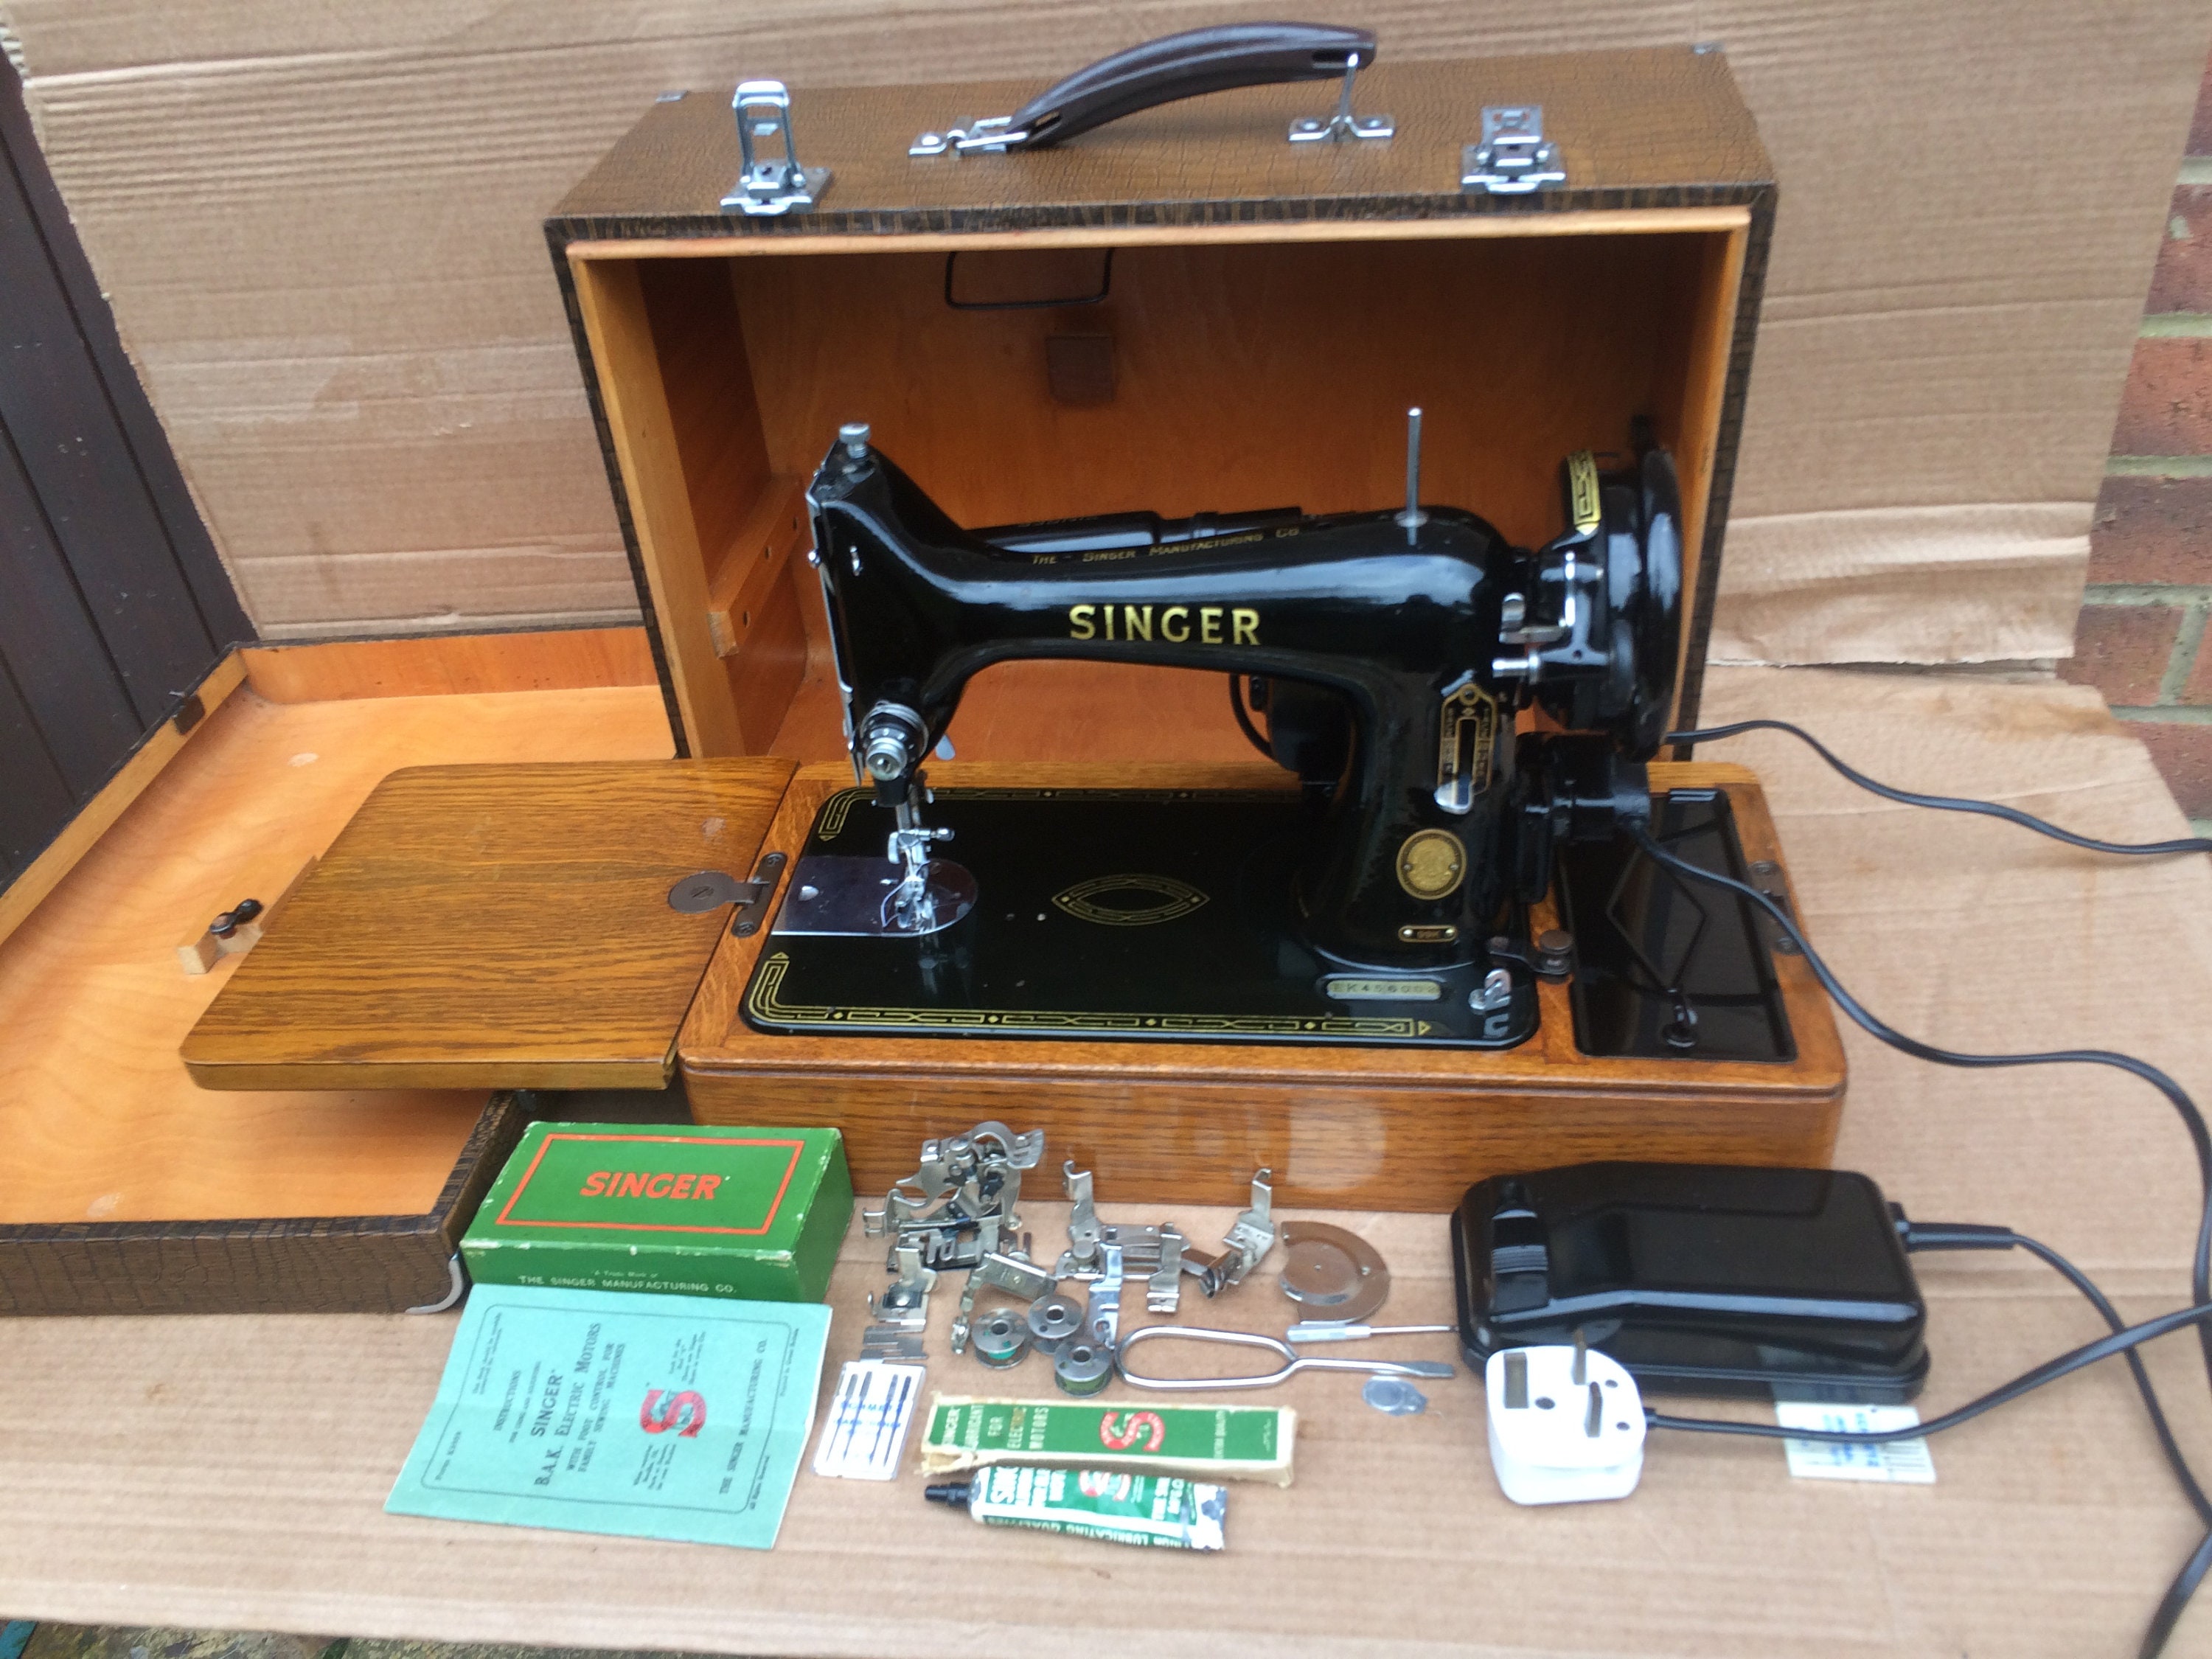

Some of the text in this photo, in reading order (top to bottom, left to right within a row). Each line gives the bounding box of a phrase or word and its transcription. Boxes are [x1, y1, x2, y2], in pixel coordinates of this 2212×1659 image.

[1082, 550, 1136, 563] SINGER
[1148, 532, 1264, 557] MANUFACTURING
[1068, 604, 1261, 646] SINGER
[579, 1170, 722, 1200] SINGER
[518, 1275, 544, 1285] THE
[549, 1276, 597, 1288] SINGER
[601, 1279, 709, 1293] MANUFACTURING
[530, 1374, 563, 1437] SINGER
[554, 1382, 585, 1436] ELECTRIC
[726, 1441, 744, 1472] SINGER
[738, 1358, 763, 1436] MANUFACTURING
[1029, 1407, 1049, 1450] MOTORS
